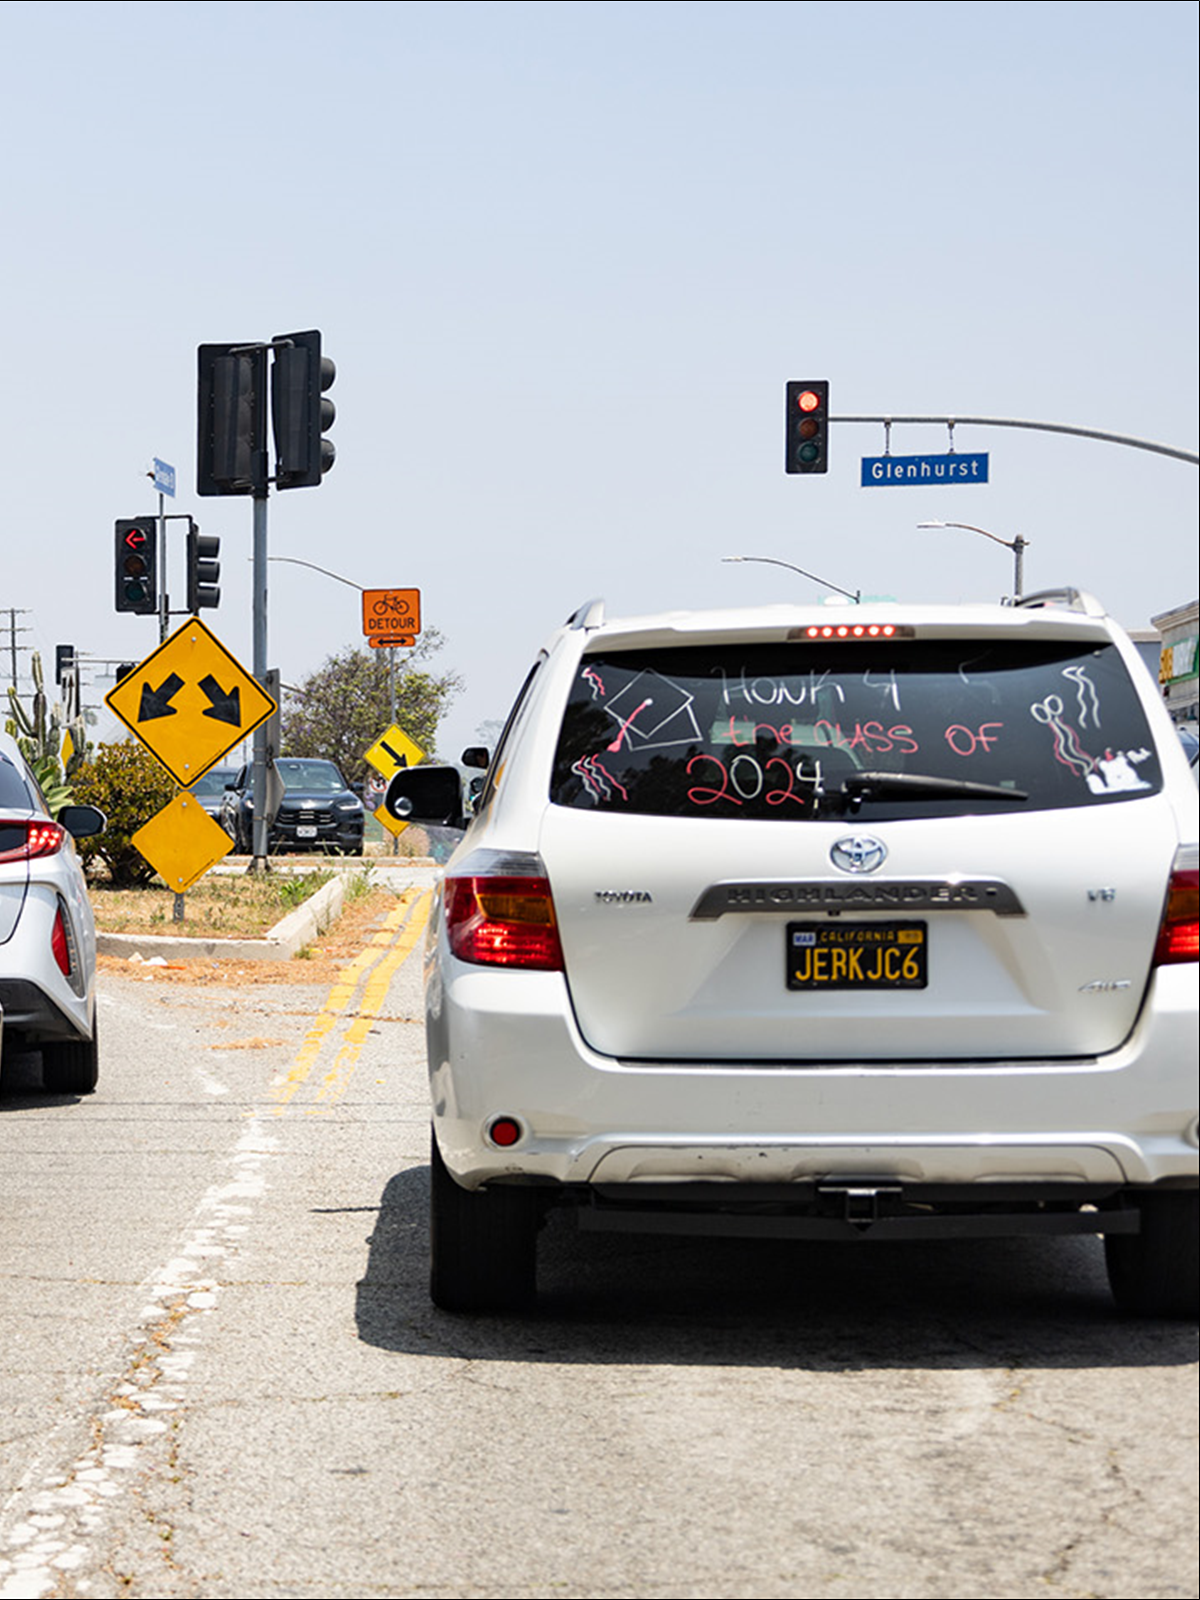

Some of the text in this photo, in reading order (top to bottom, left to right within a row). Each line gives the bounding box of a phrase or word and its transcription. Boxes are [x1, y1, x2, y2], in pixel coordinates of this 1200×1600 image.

[871, 460, 979, 479] Glenhurst
[368, 617, 416, 630] DETOUR
[711, 666, 901, 712] HONK 4
[945, 722, 1004, 756] OF
[686, 754, 826, 808] 2024
[594, 889, 653, 904] TOYOTA
[726, 886, 979, 903] HIGHLANDER
[820, 930, 895, 943] CALIFORNIA
[795, 946, 919, 981] JERKJC6
